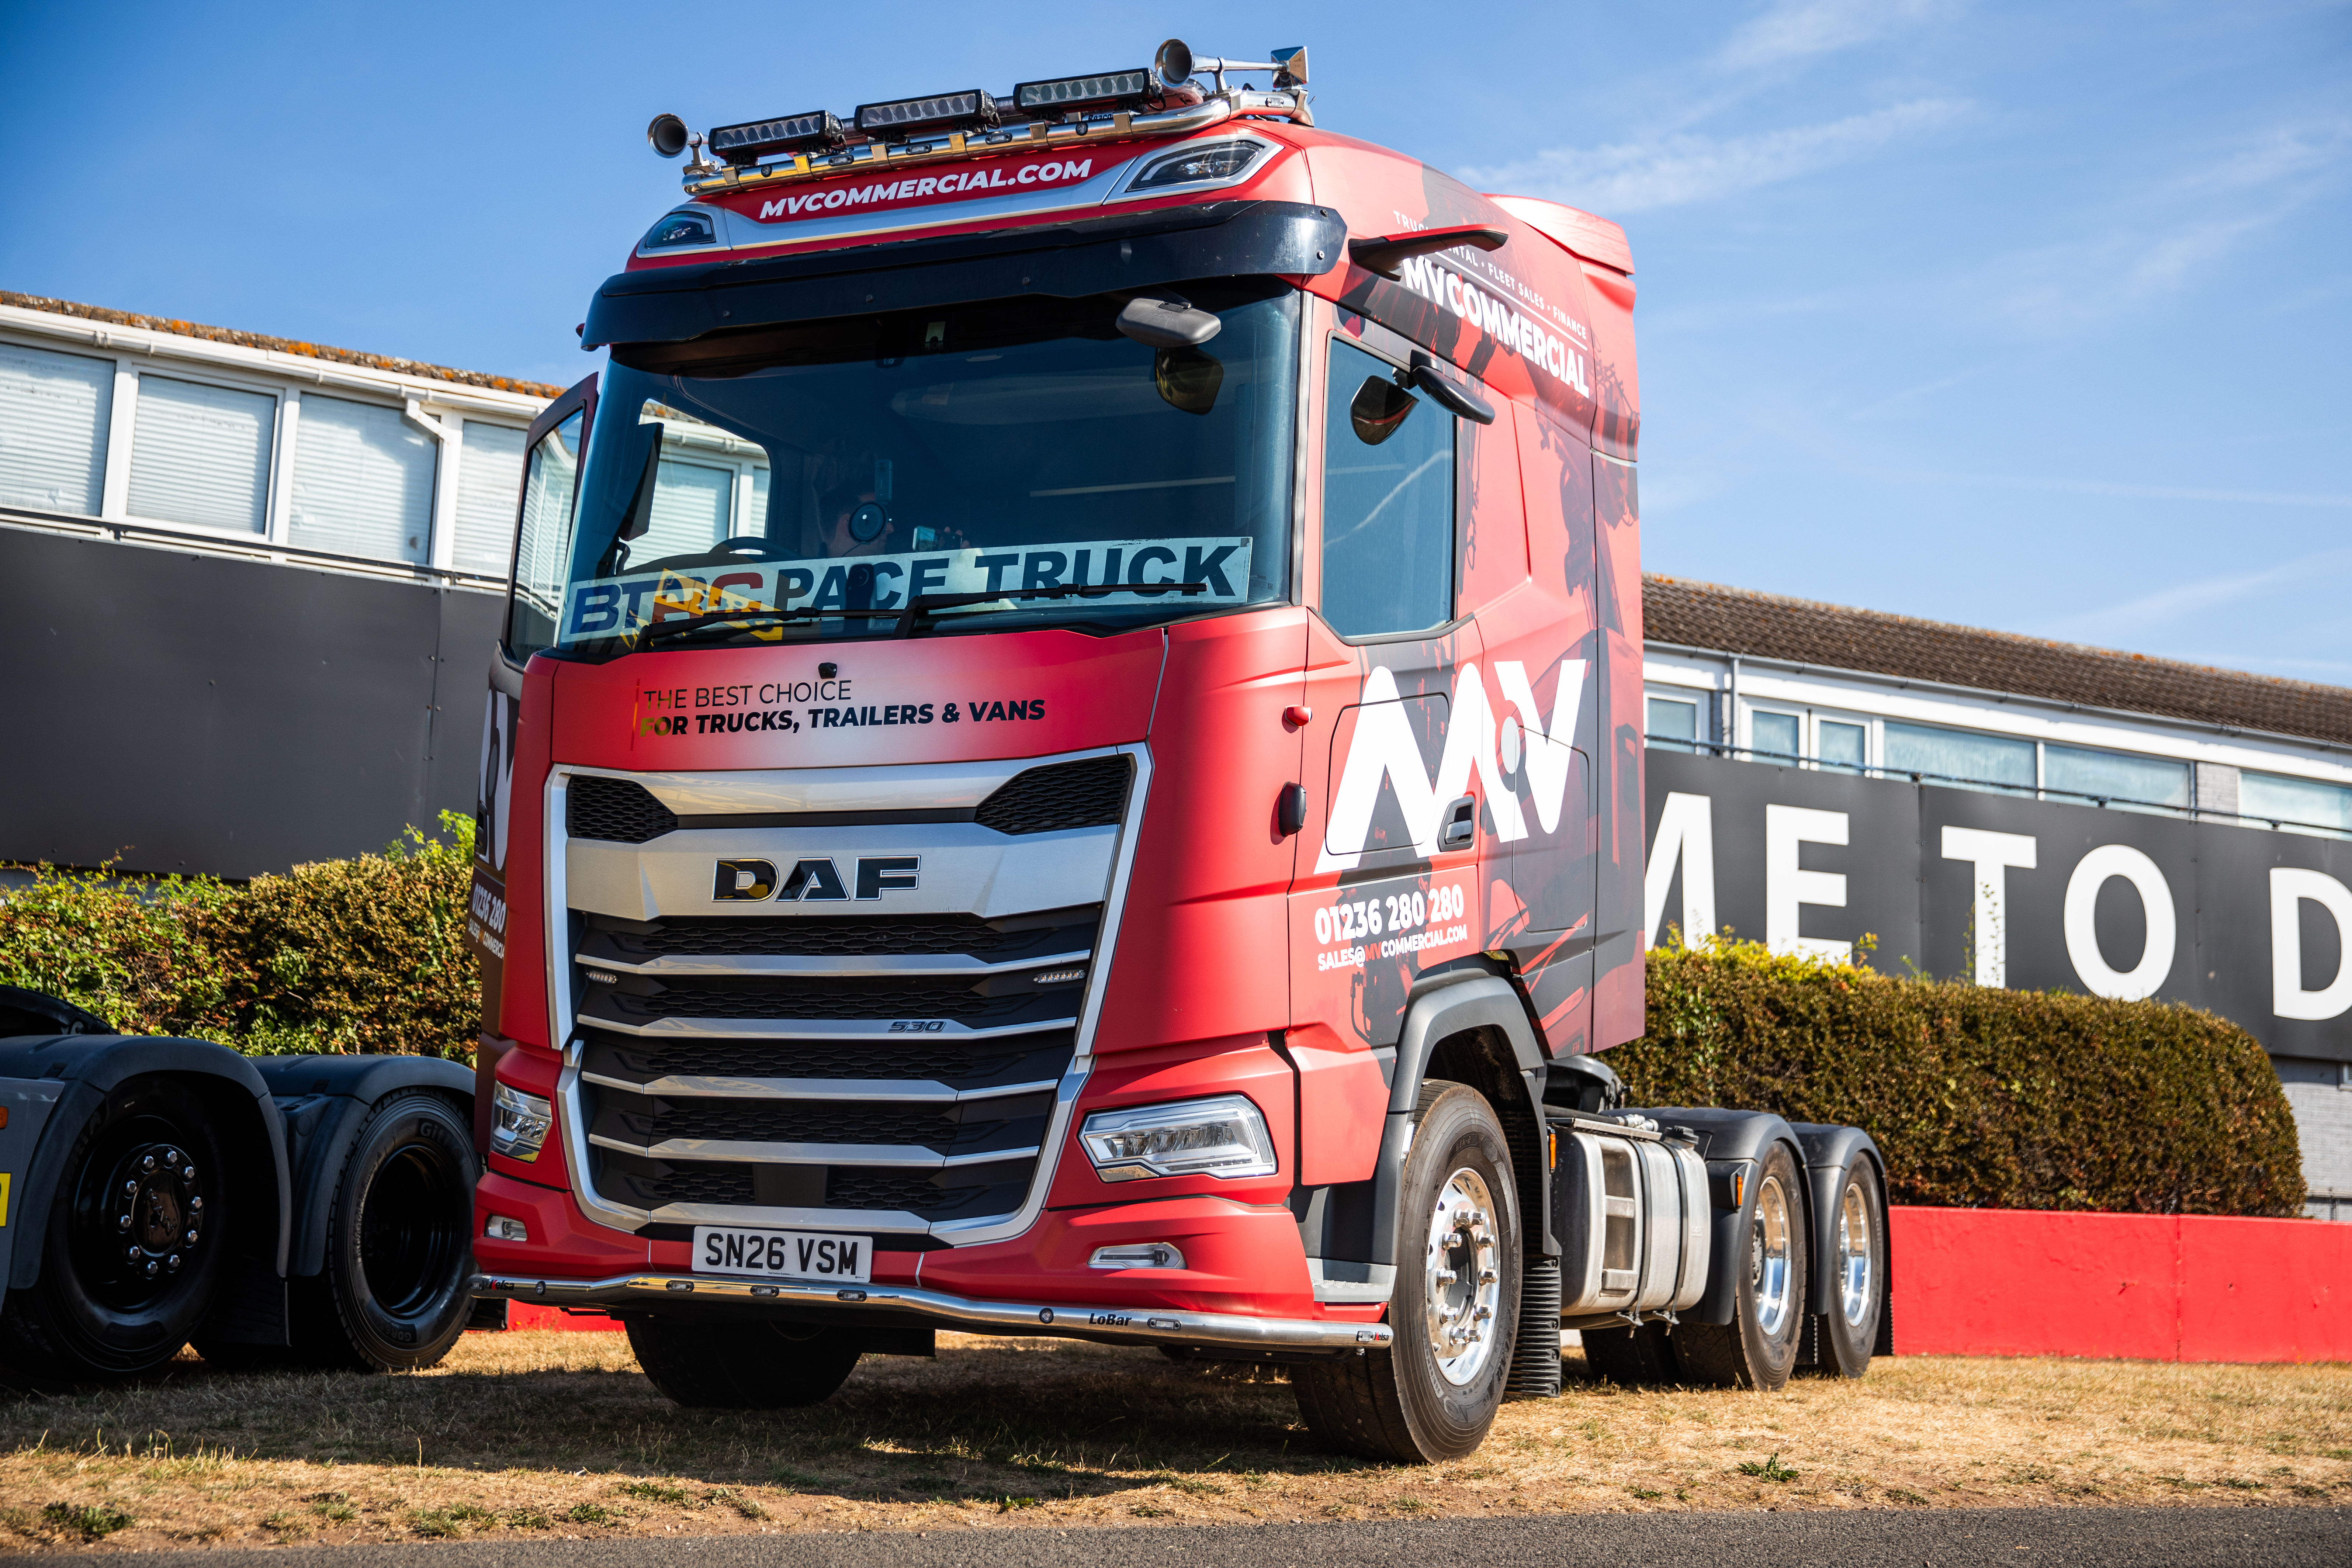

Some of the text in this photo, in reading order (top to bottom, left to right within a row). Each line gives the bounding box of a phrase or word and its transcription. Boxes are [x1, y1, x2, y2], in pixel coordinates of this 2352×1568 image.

[758, 158, 1092, 220] MVCOMMERCIAL.COM
[1393, 210, 1586, 340] TRUC NTAL FLEET SALES FINANCE
[1402, 255, 1590, 399] MVCOMMERCIAL
[774, 558, 950, 613] PACE
[974, 546, 1240, 604] TRUCK
[640, 699, 1045, 737] FOR TRUCKS, TRAILERS & VANS
[644, 680, 852, 710] THE BEST CHOICE
[1313, 659, 1586, 875] MV
[711, 855, 921, 903] DAF
[488, 896, 506, 933] 280
[1314, 884, 1464, 945] 01236 280 280
[1941, 825, 2176, 1002] TO
[1317, 924, 1467, 971] SALES@MVCOMMERCIAL.COM
[888, 1021, 946, 1033] 530
[705, 1232, 858, 1275] SN26 VSM
[1089, 1313, 1132, 1326] LoBar
